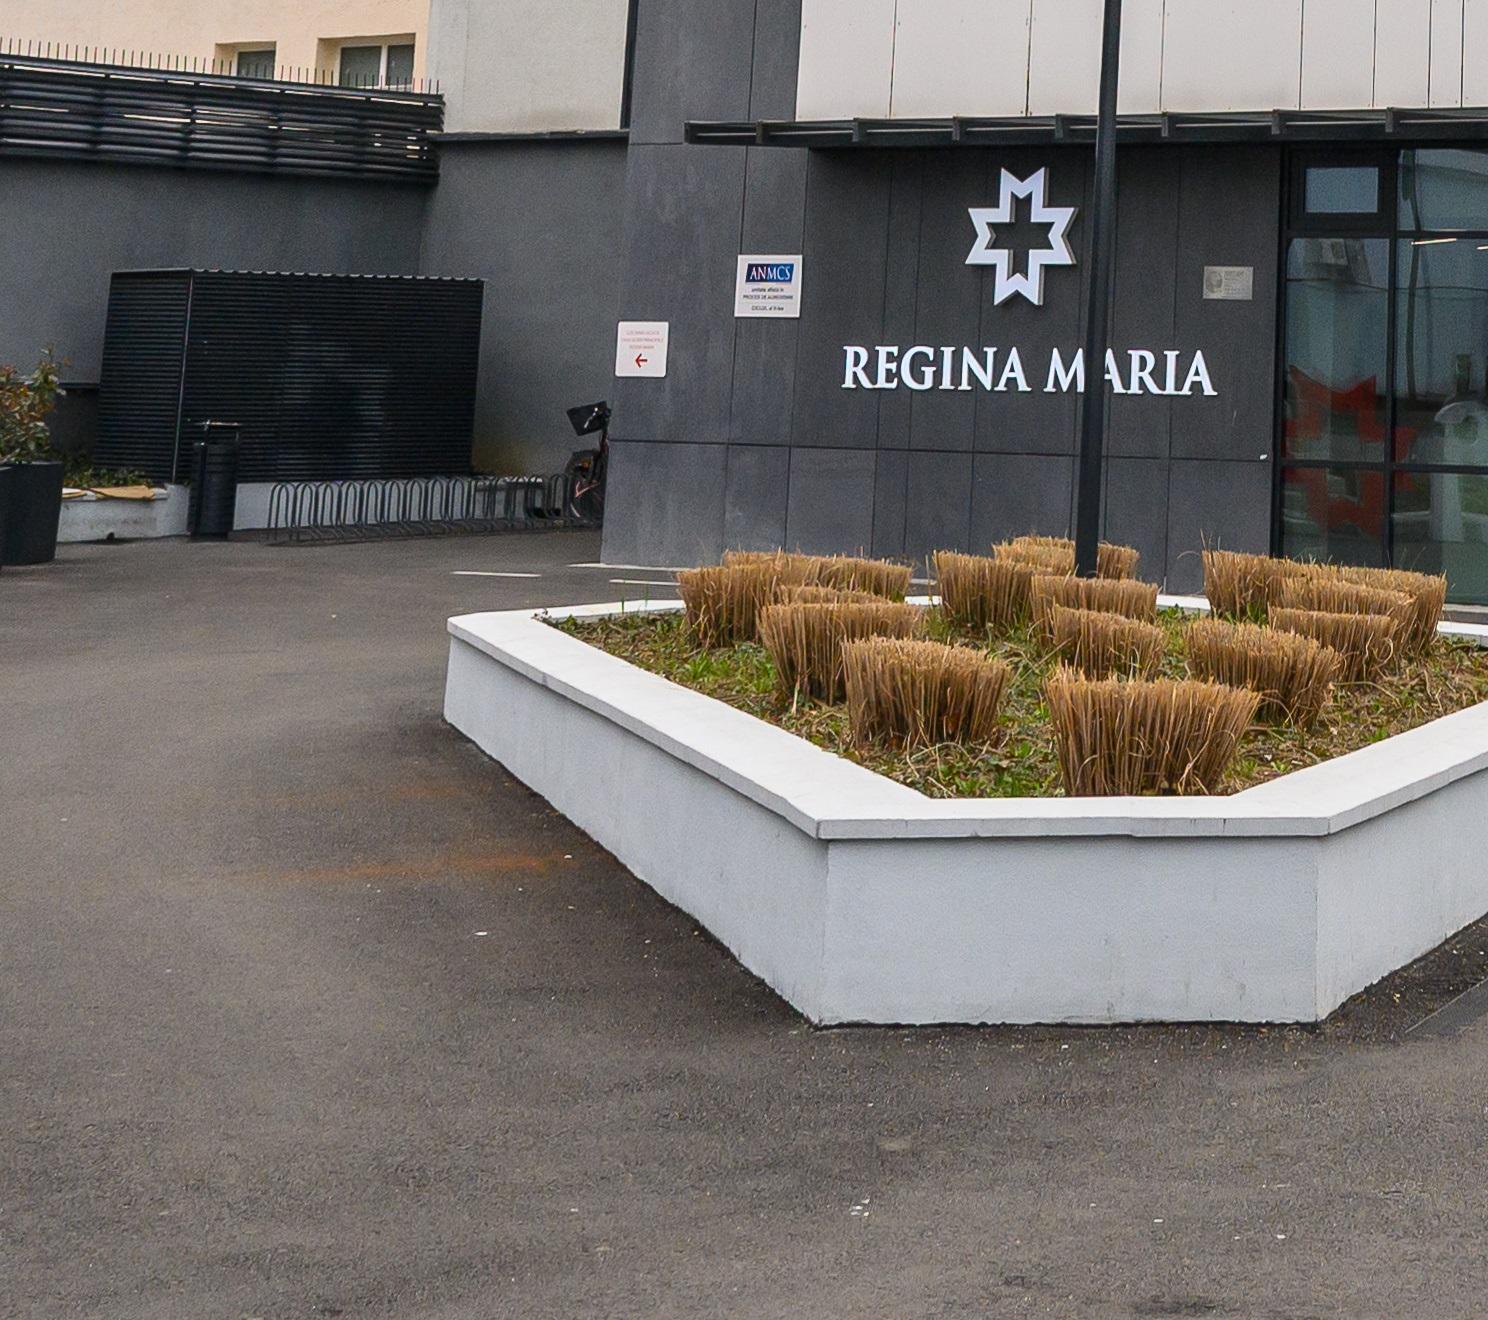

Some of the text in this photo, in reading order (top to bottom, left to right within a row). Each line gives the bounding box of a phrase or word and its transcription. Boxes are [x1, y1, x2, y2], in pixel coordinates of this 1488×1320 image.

[750, 265, 791, 281] ANMCS
[840, 345, 1218, 396] REGINA MARIA
